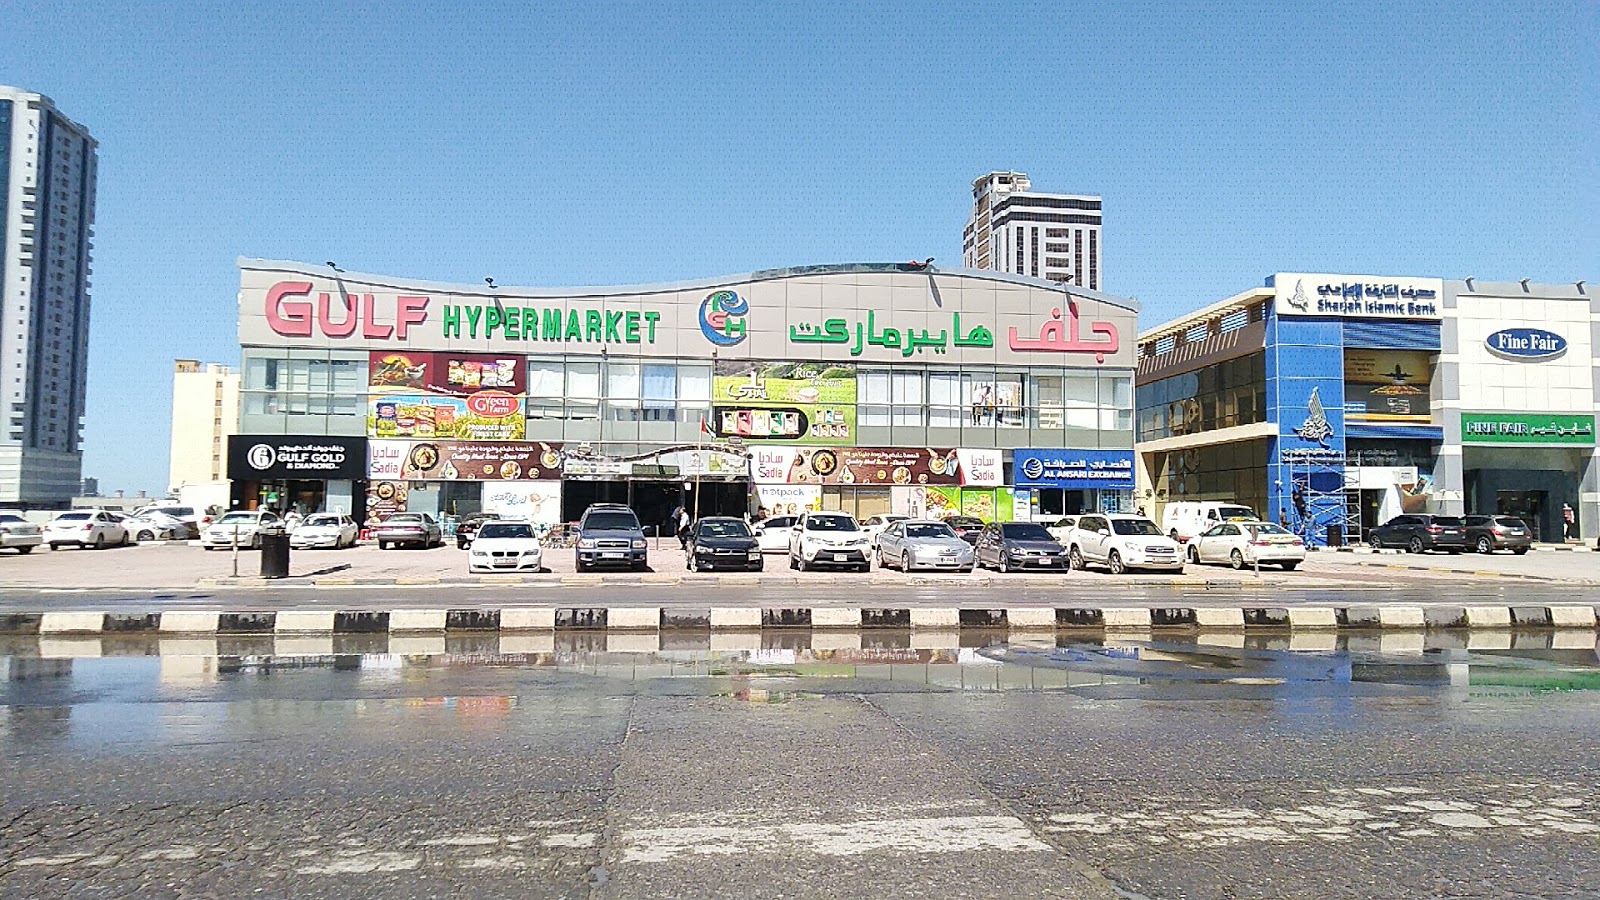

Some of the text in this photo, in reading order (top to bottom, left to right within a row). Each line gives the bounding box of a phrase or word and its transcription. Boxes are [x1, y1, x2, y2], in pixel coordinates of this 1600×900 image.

[1365, 284, 1399, 299] الشارقة
[1401, 286, 1436, 301] مصرف
[265, 280, 660, 344] GULF HYPERMARKET
[1317, 299, 1437, 316] Sharjah Islamic Bank
[789, 301, 1119, 363] جلف هايبرماركت
[1498, 333, 1559, 351] Fine Fair
[795, 368, 818, 379] Rice
[474, 394, 509, 411] Green
[1466, 421, 1529, 435] FINE FAIR
[277, 453, 345, 463] GULF GOLD
[372, 445, 399, 461] ساديا
[758, 451, 783, 465] ساديا
[370, 462, 399, 474] Sadia
[971, 454, 995, 468] ساديا
[758, 466, 783, 479] Sadia
[971, 468, 995, 481] Sadia
[1043, 470, 1132, 479] AL ANSARI EXCHANGE
[762, 487, 805, 497] hotpack
